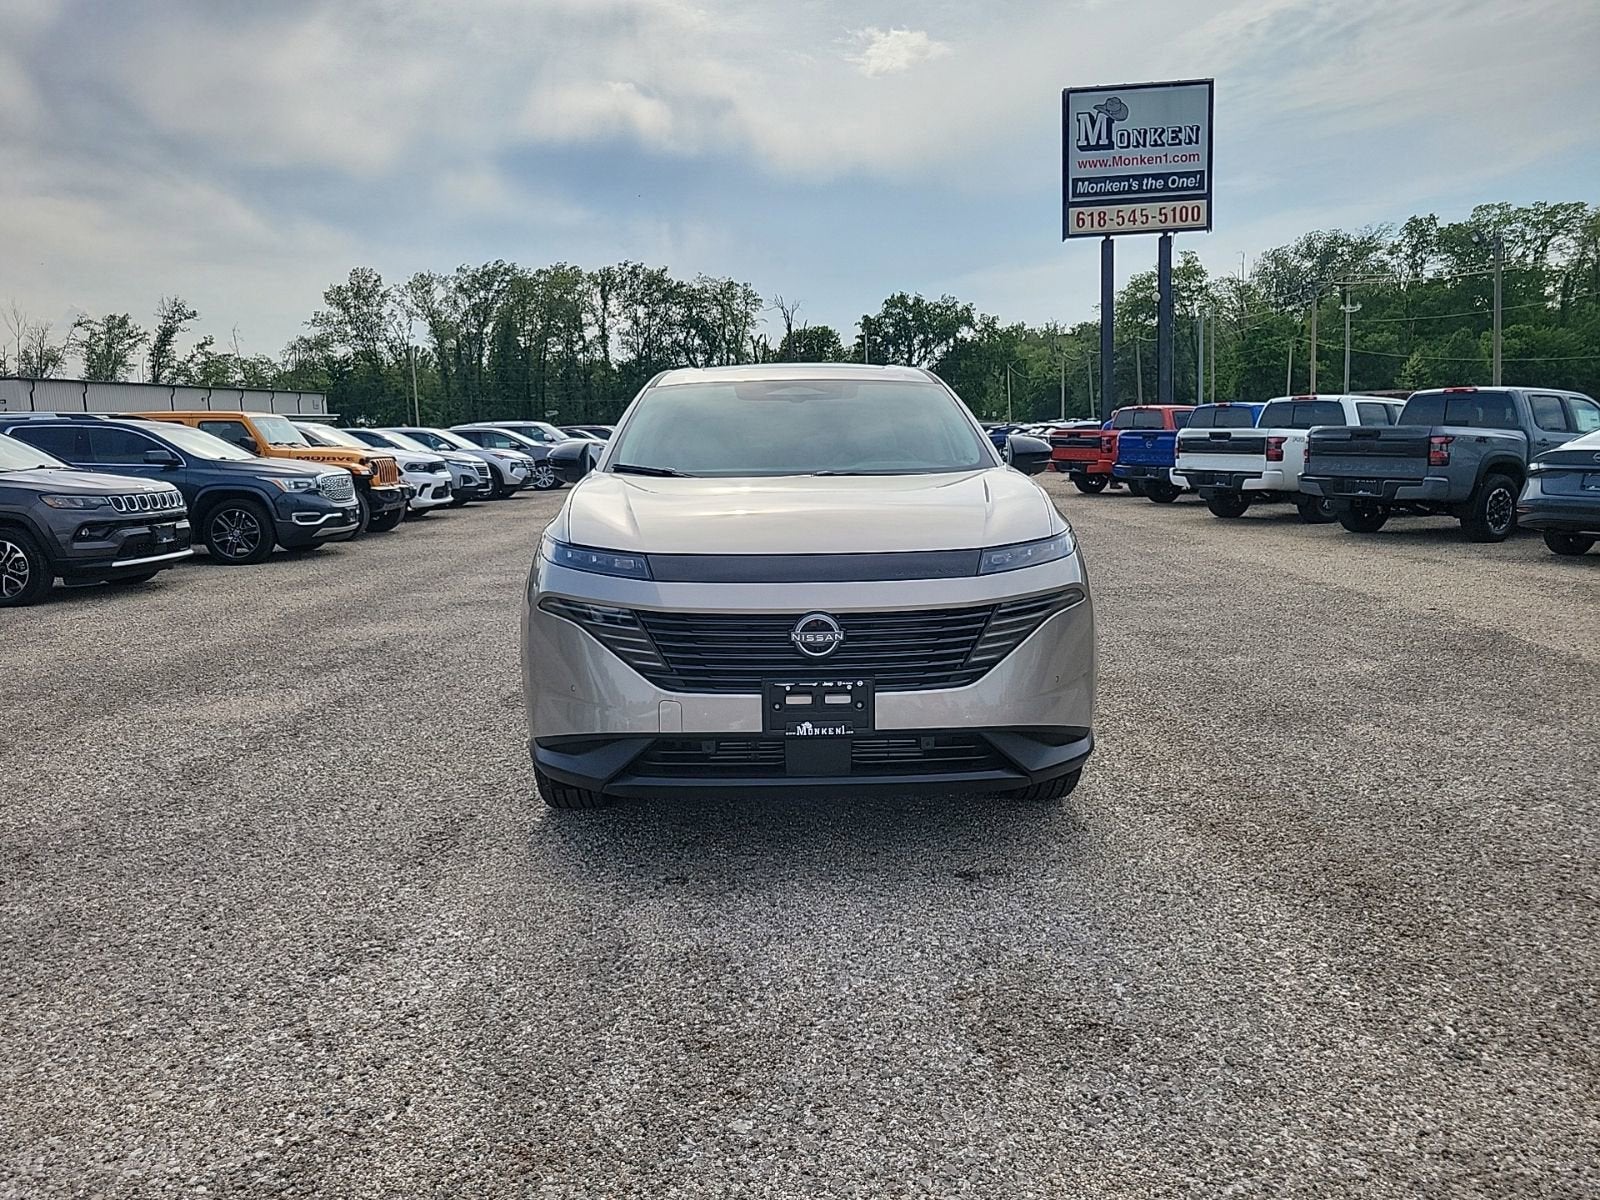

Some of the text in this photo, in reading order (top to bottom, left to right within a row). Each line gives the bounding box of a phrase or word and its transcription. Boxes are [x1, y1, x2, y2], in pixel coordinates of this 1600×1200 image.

[1076, 111, 1200, 152] MONKEN
[1077, 153, 1200, 169] www.Monken1.com
[1076, 175, 1200, 194] Monken's the One!
[1075, 205, 1201, 229] 618-545-5100
[791, 632, 843, 641] NISSAN
